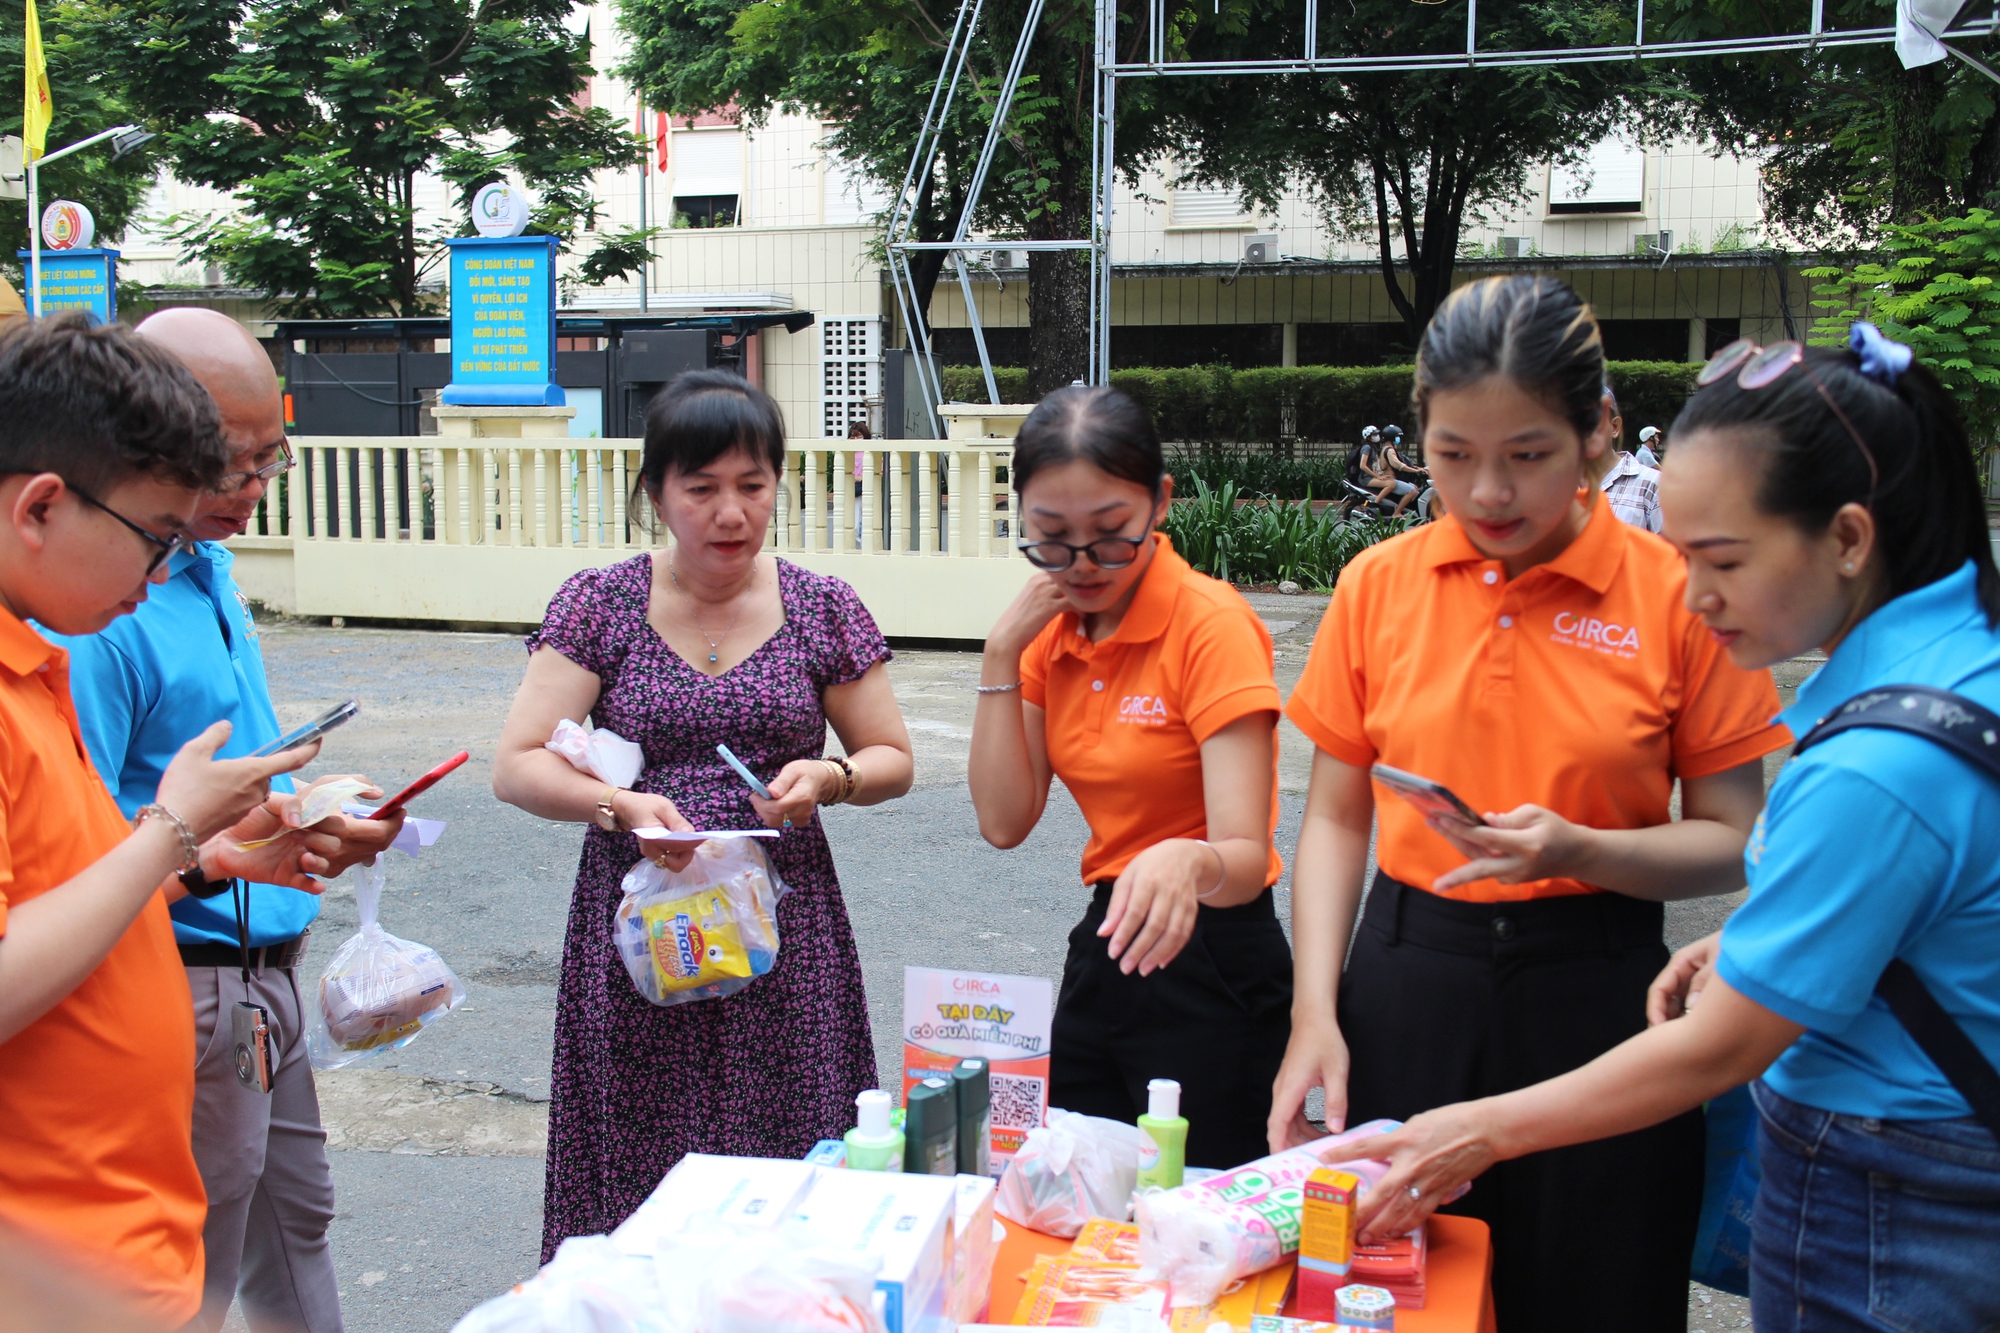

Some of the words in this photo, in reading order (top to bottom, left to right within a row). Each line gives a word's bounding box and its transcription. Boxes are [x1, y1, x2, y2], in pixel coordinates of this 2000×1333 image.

[465, 258, 483, 270] CÔNG
[484, 257, 502, 269] ĐOÀN
[504, 257, 517, 271] VIỆT
[519, 259, 535, 269] NAM
[517, 276, 530, 289] TẠO
[489, 309, 507, 321] ĐOÀN
[494, 327, 507, 338] LAO
[1553, 611, 1640, 651] CIRCA
[675, 913, 701, 978] Enaak
[953, 977, 1001, 994] CIRCA
[937, 1003, 970, 1022] TẠI
[972, 1002, 1014, 1025] ĐÂY
[910, 1023, 934, 1040] CÓ
[935, 1024, 970, 1041] QUÀ
[971, 1024, 1011, 1046] MIỄN
[1012, 1033, 1042, 1052] PHÍ
